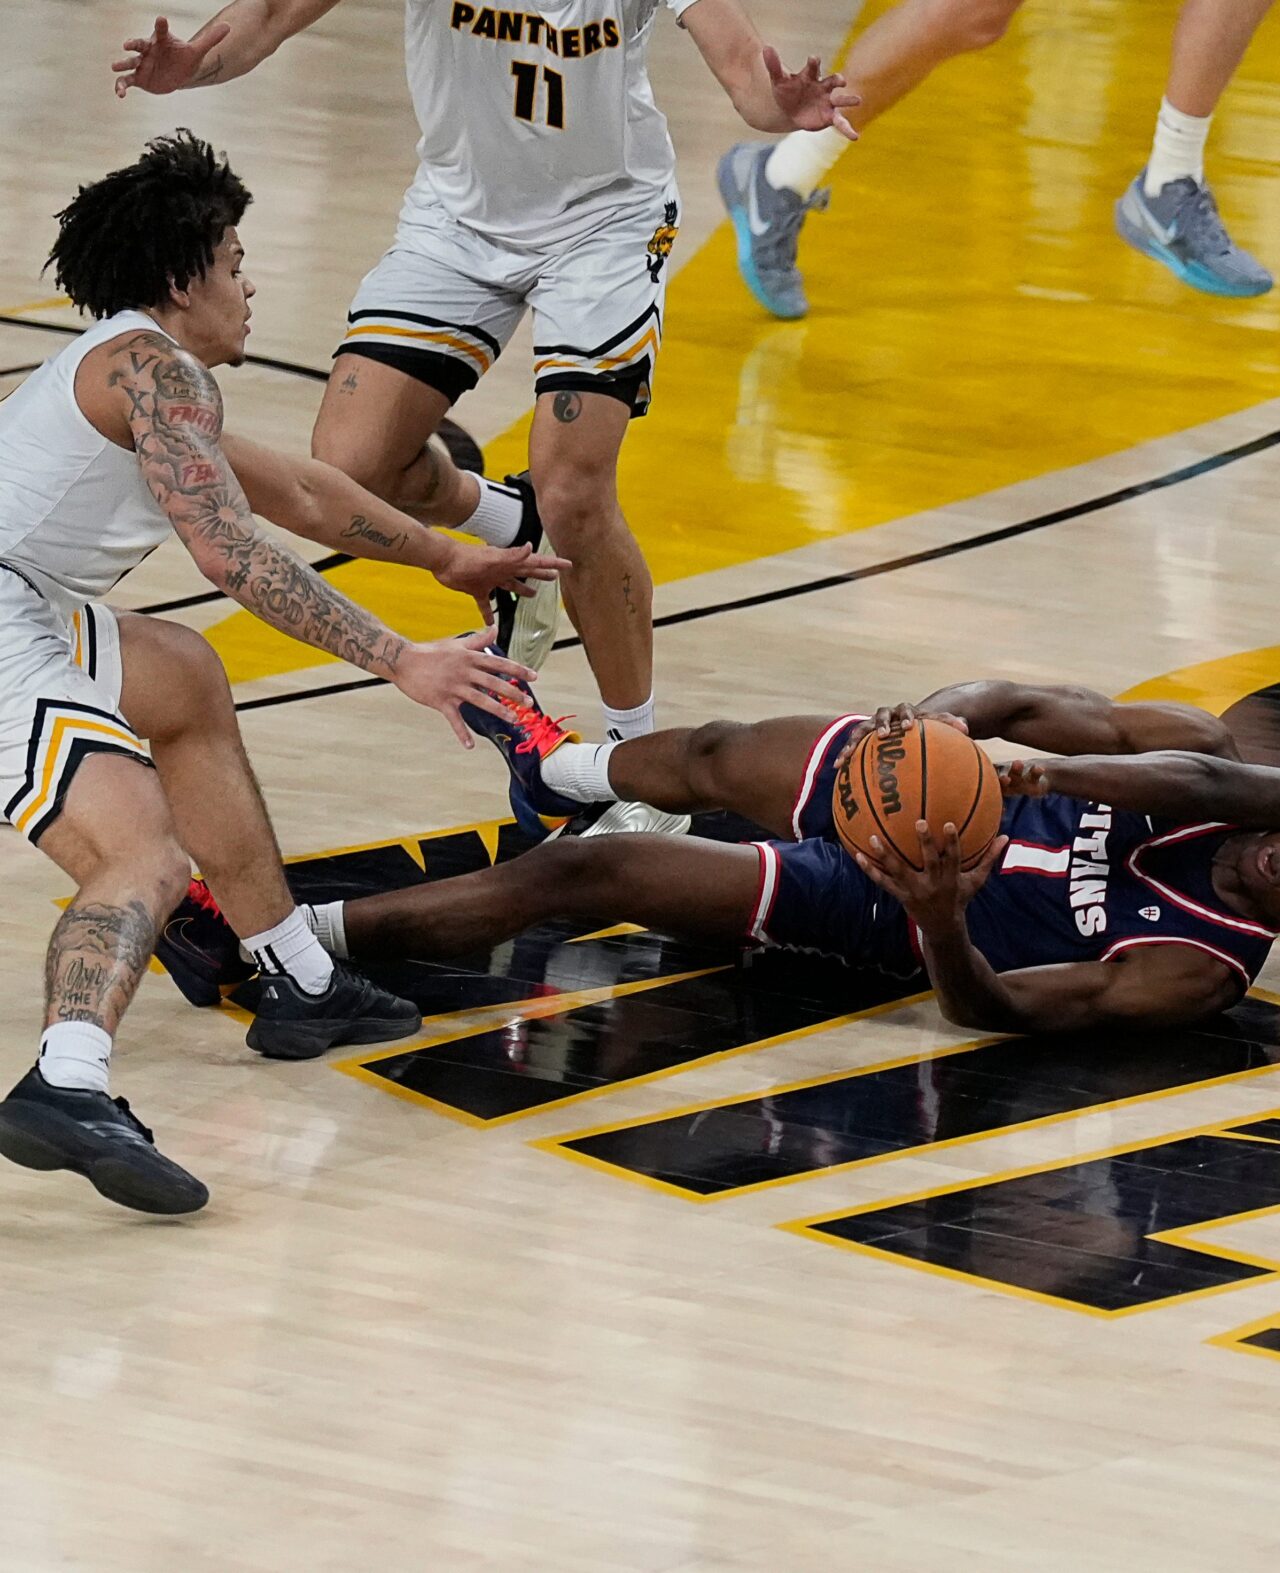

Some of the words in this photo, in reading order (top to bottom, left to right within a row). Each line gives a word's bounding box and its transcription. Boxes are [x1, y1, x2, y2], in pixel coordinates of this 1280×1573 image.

[450, 1, 622, 59] PANTHERS
[511, 59, 566, 131] 11
[250, 575, 304, 625] GOD
[838, 757, 860, 822] CAA
[1069, 800, 1112, 938] ITANS
